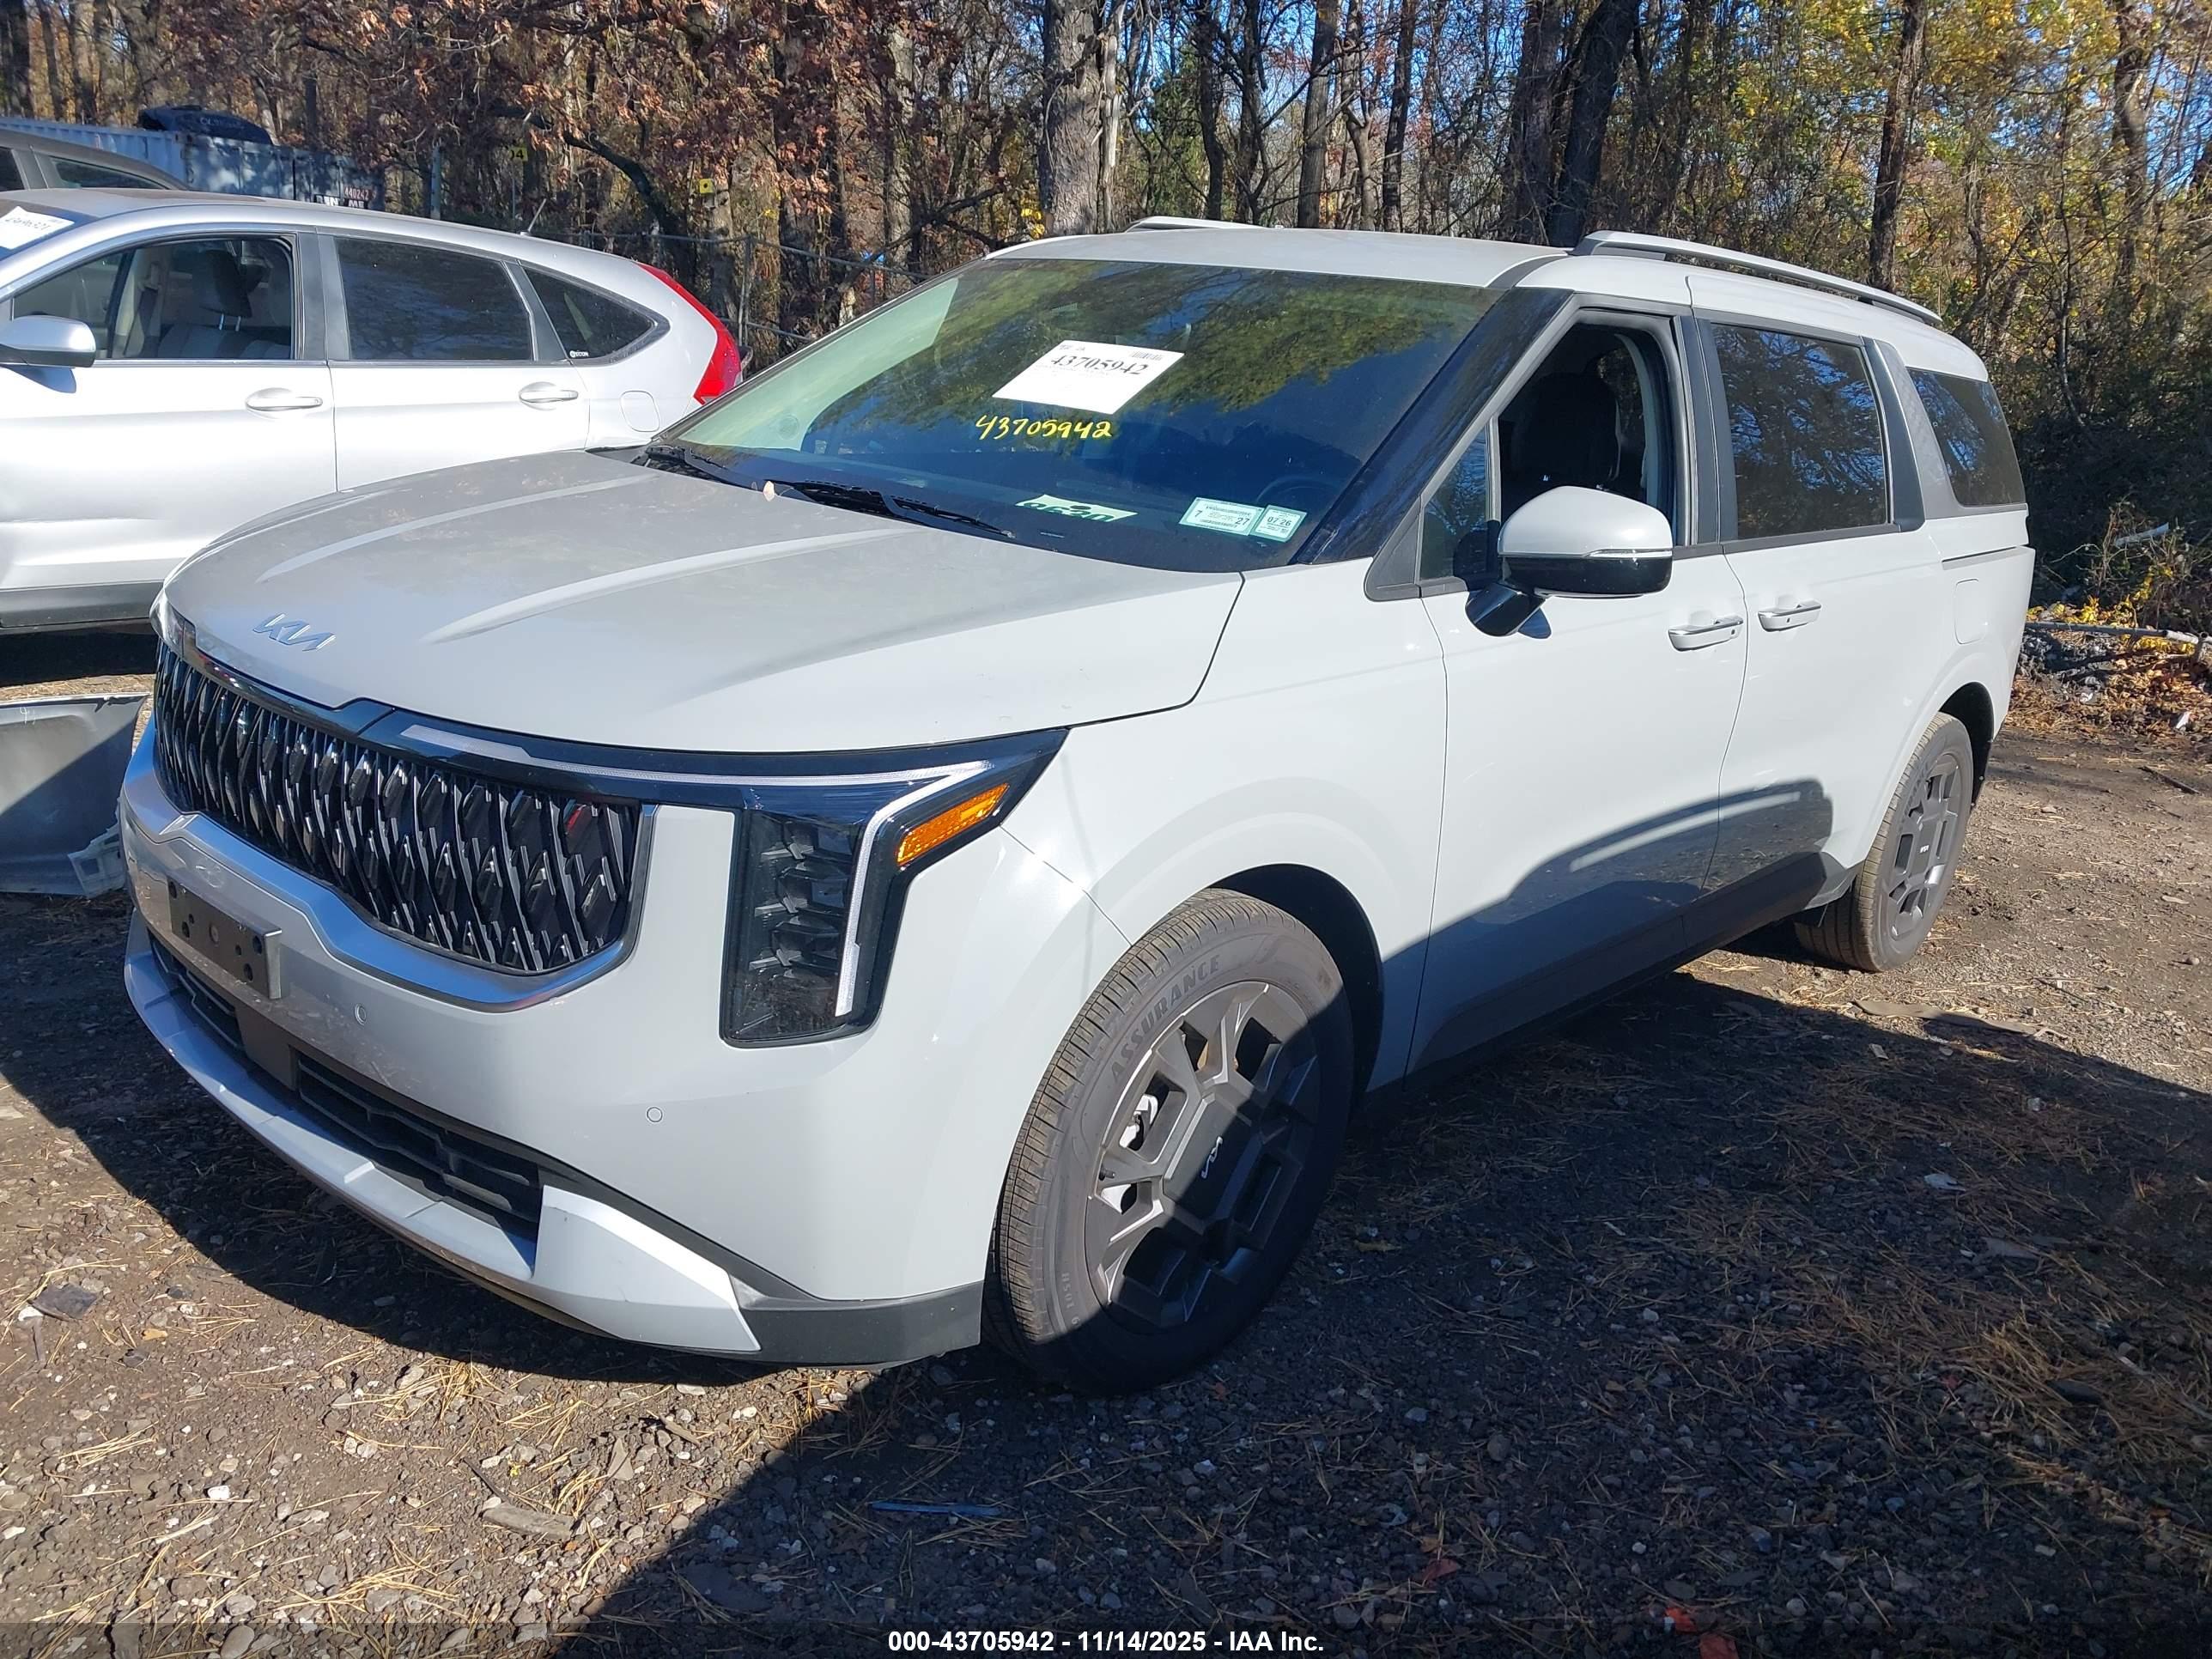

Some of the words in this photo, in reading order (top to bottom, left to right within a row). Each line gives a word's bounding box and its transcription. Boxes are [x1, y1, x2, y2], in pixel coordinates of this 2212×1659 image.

[1049, 354, 1149, 375] 43705942
[975, 414, 1113, 441] 43705942
[1235, 517, 1250, 526] 27
[252, 612, 337, 653] KIA
[1111, 954, 1221, 1084] ASSURANCE
